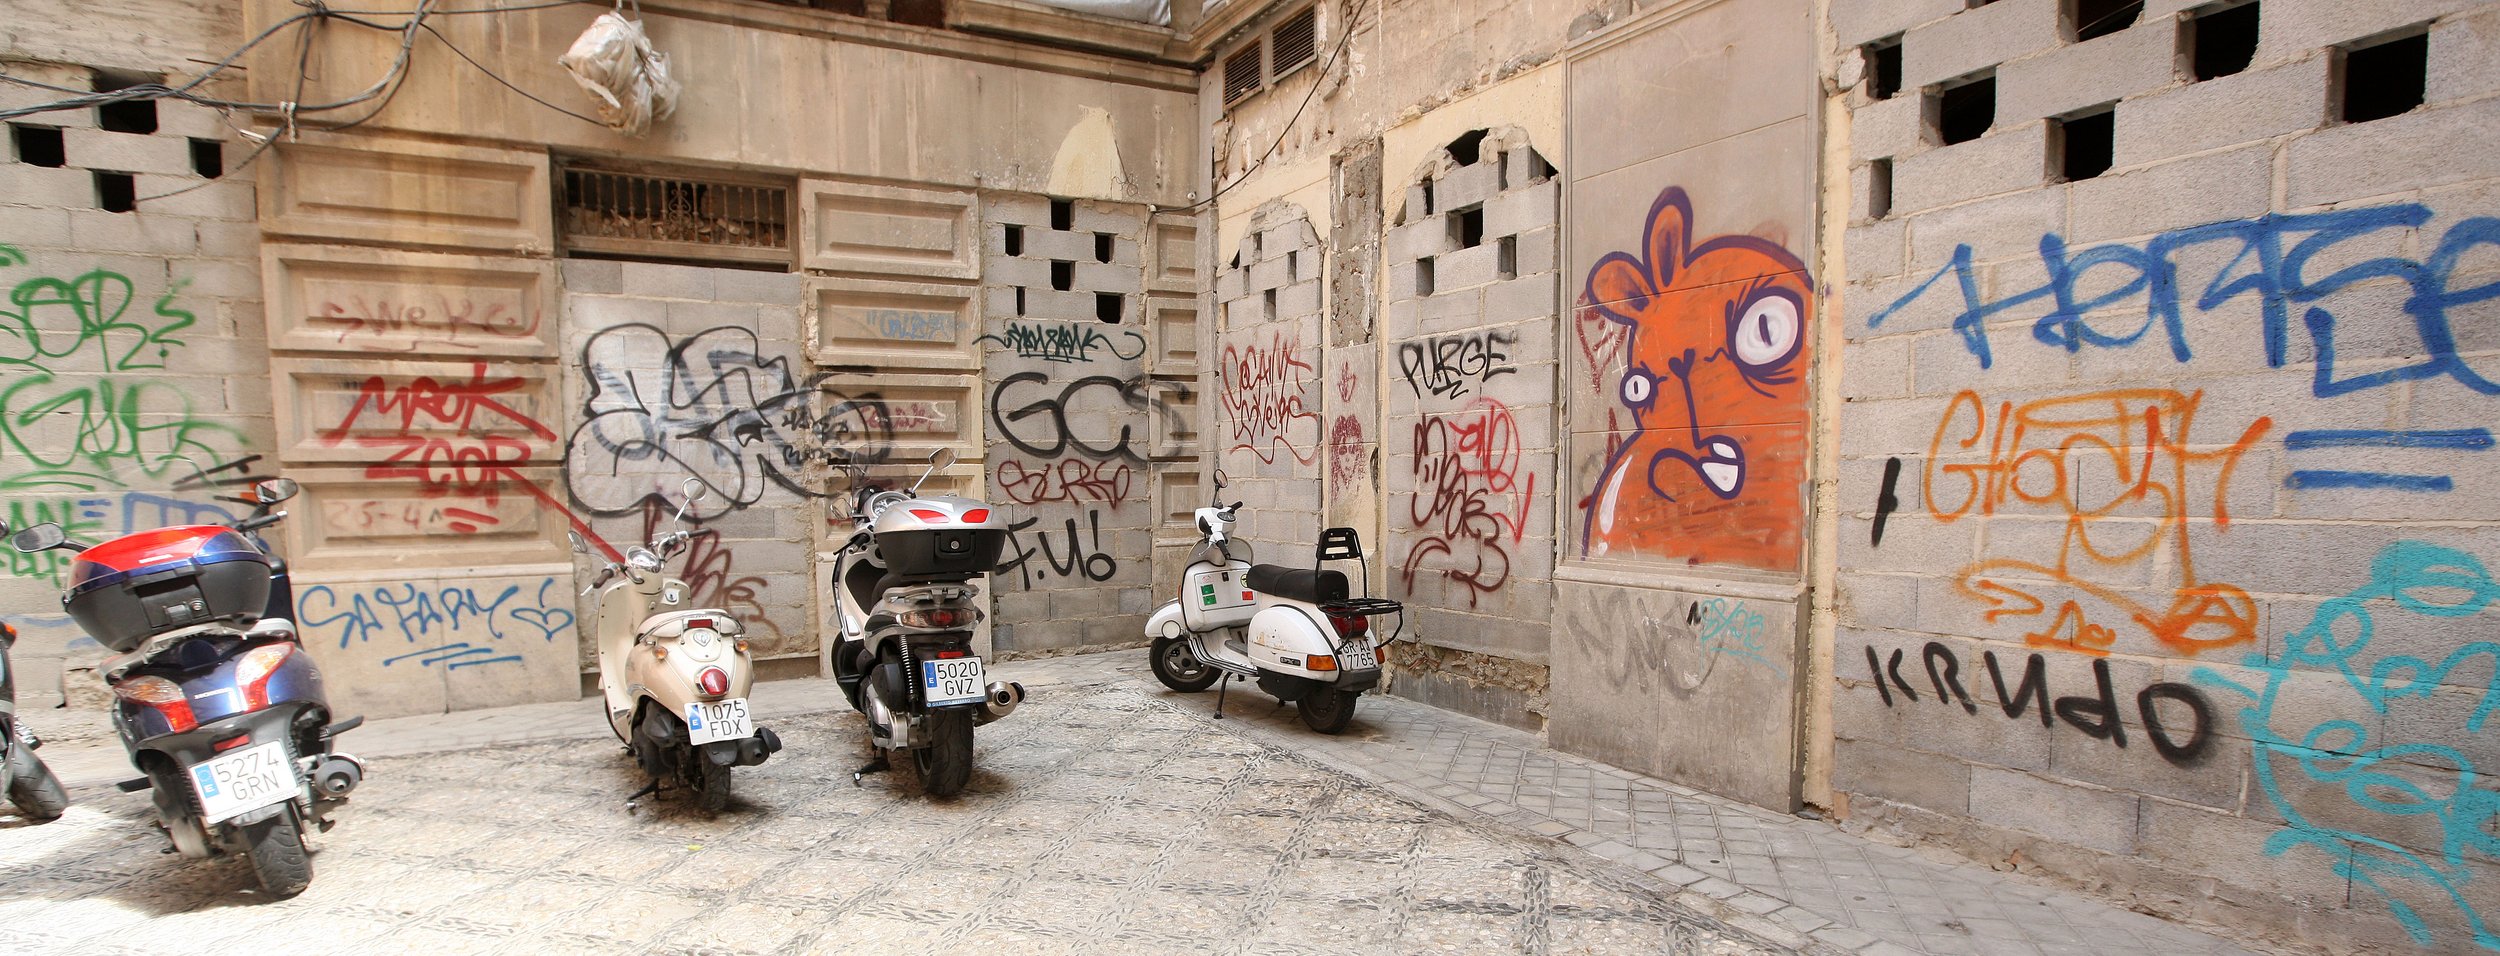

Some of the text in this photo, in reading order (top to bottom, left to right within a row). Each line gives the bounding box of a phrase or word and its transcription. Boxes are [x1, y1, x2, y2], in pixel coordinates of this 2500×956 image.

[1398, 332, 1518, 400] PURGE
[1347, 652, 1375, 667] 7765
[937, 661, 979, 680] 5020
[945, 678, 975, 696] GVZ
[702, 701, 746, 722] 1075
[710, 719, 743, 738] FDX
[215, 748, 279, 783] 5274
[231, 770, 280, 802] GRN
